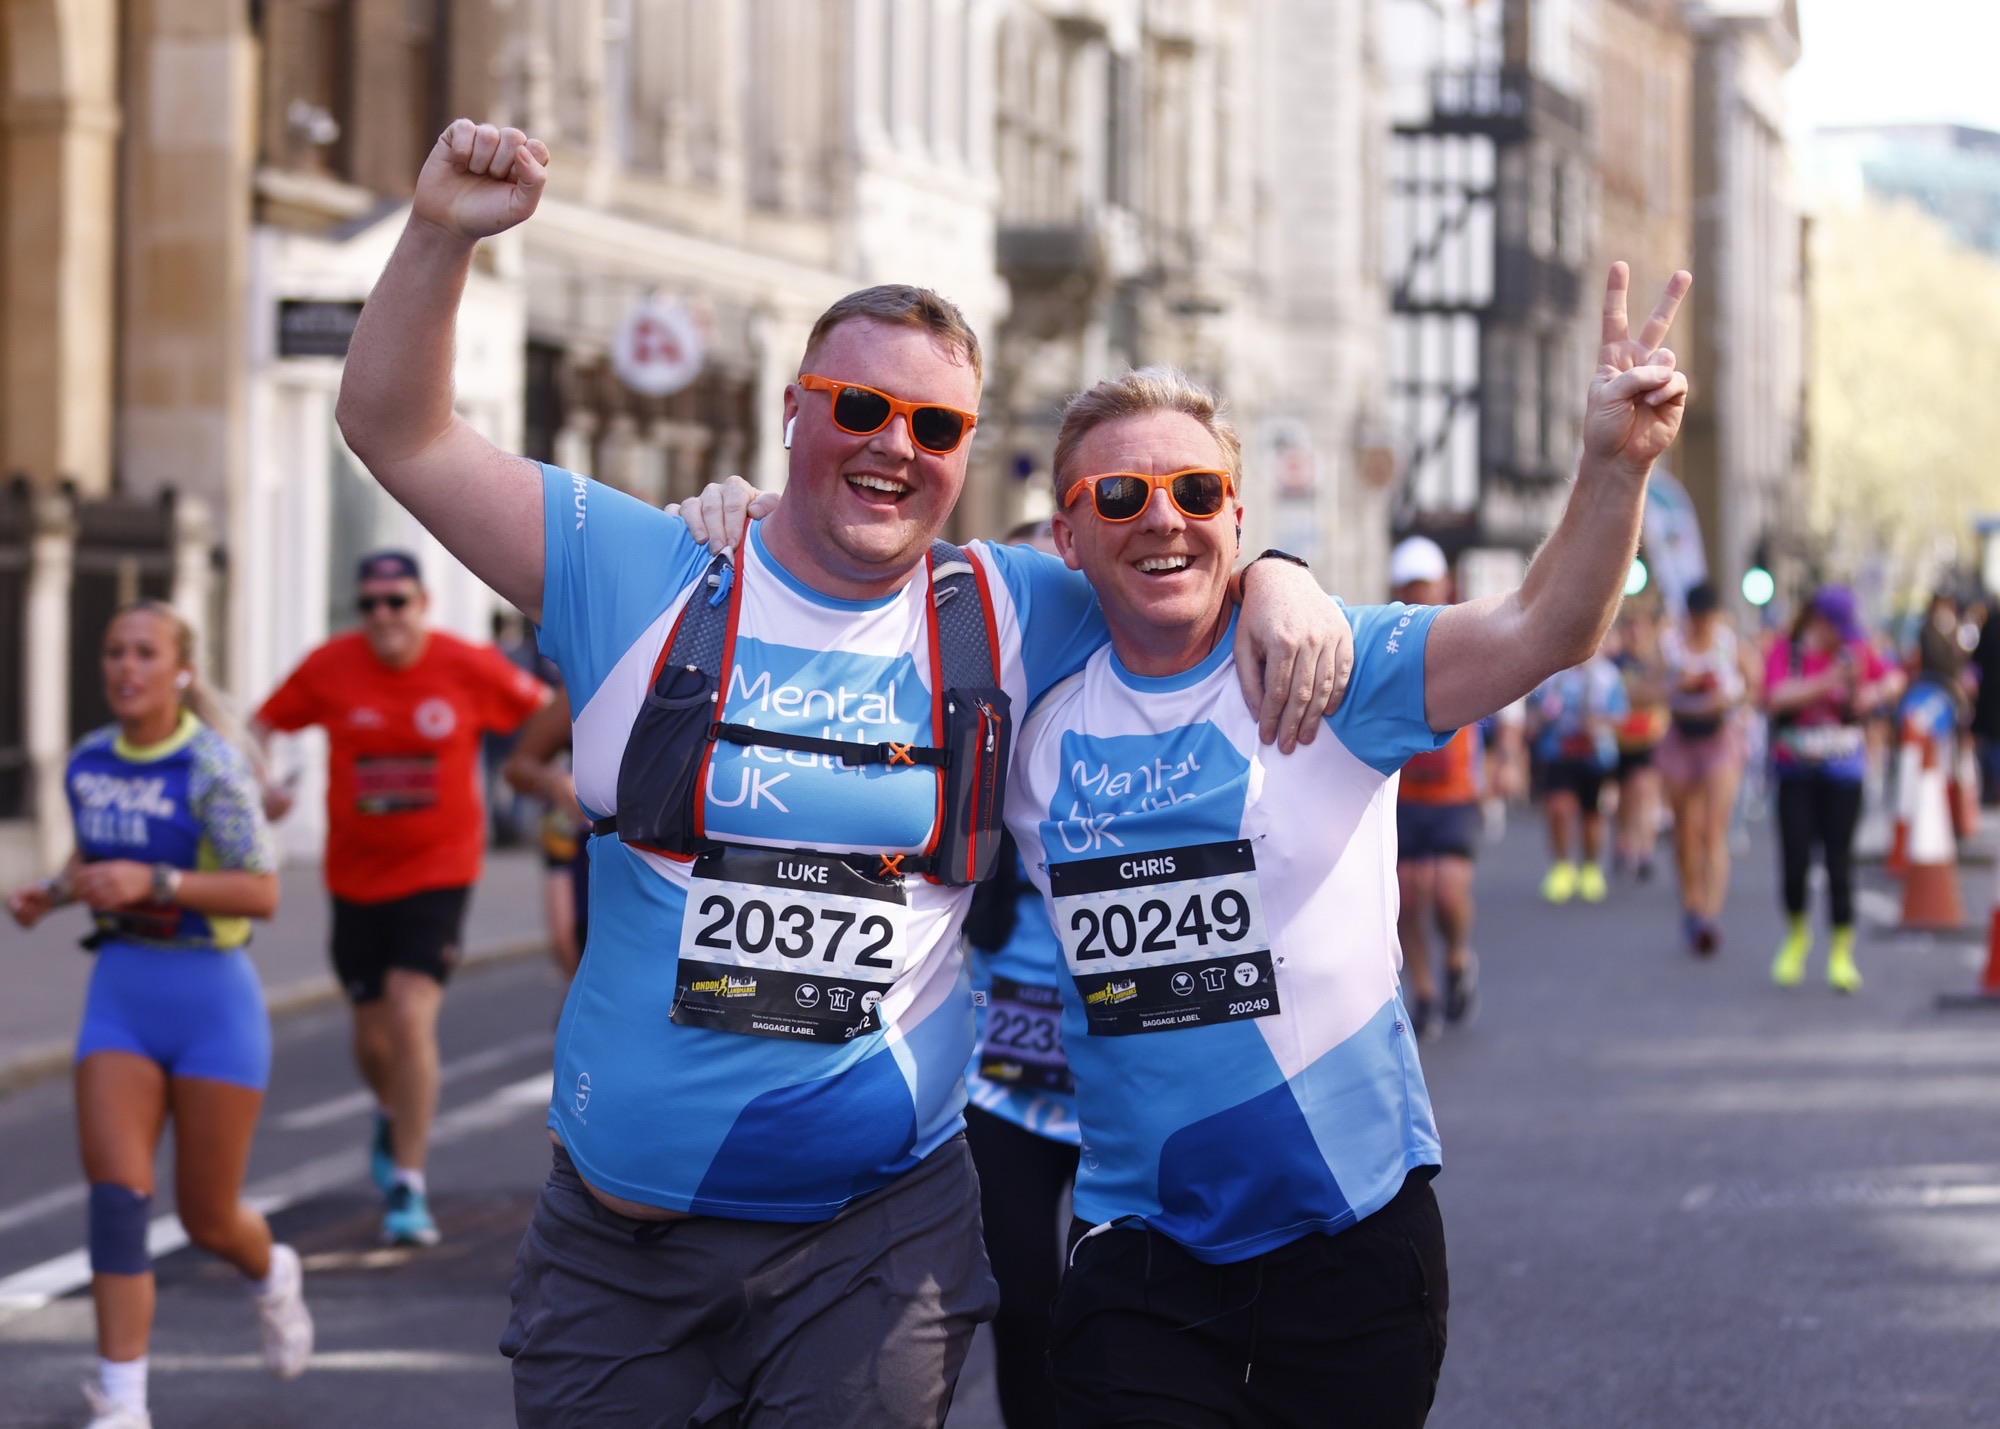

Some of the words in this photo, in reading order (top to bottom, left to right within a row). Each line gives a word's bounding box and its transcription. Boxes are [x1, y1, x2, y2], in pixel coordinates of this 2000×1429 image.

[1386, 606, 1421, 654] #Tea
[725, 664, 900, 724] Mental
[984, 756, 994, 789] INOX
[706, 762, 791, 813] UK
[1057, 817, 1125, 854] UK
[777, 861, 829, 884] LUKE
[1119, 856, 1176, 879] CHRIS
[694, 894, 894, 969] 20372
[1070, 889, 1251, 961] 20249
[691, 980, 720, 991] LONDON
[1211, 974, 1218, 987] L
[1243, 973, 1250, 983] 7
[834, 993, 845, 1007] XL
[869, 1002, 876, 1010] 7
[1228, 998, 1270, 1015] 20249
[752, 1021, 790, 1032] BAGGAGE
[791, 1026, 815, 1035] LABEL
[989, 1010, 1064, 1053] 223
[1142, 1017, 1176, 1028] BAGGAGE
[1177, 1014, 1200, 1023] LABEL
